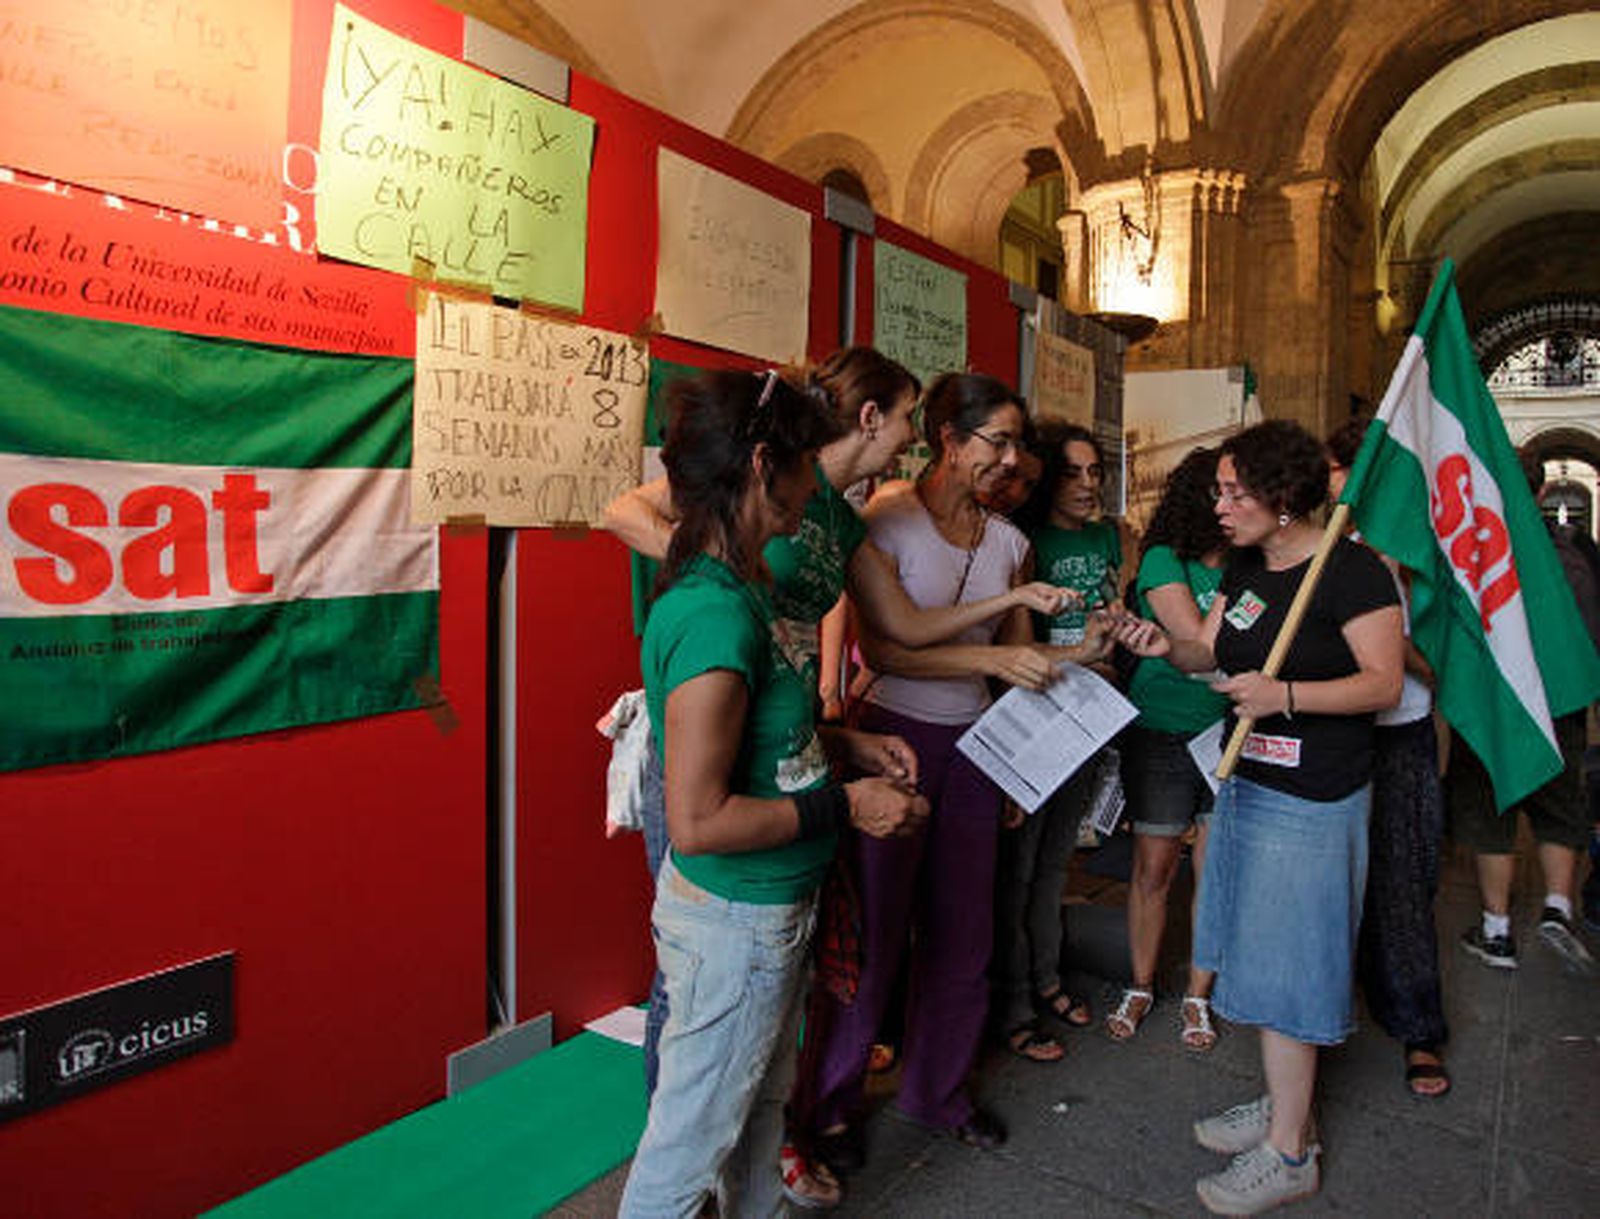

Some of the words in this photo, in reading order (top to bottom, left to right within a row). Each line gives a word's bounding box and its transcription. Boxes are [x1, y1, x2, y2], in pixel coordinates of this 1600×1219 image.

[340, 122, 564, 215] COMPAÑEROS
[374, 176, 424, 212] EN
[467, 204, 509, 247] LA
[11, 225, 48, 256] de
[59, 232, 88, 263] la
[102, 240, 261, 296] Universidad
[266, 276, 287, 302] de
[354, 211, 536, 285] CALLE
[81, 277, 200, 321] Cultural
[205, 300, 235, 325] de
[240, 309, 278, 333] sus
[583, 335, 647, 387] 2013
[592, 388, 622, 428] 8
[7, 474, 274, 605] sat
[1431, 453, 1521, 636] sat
[118, 1010, 208, 1056] cicus
